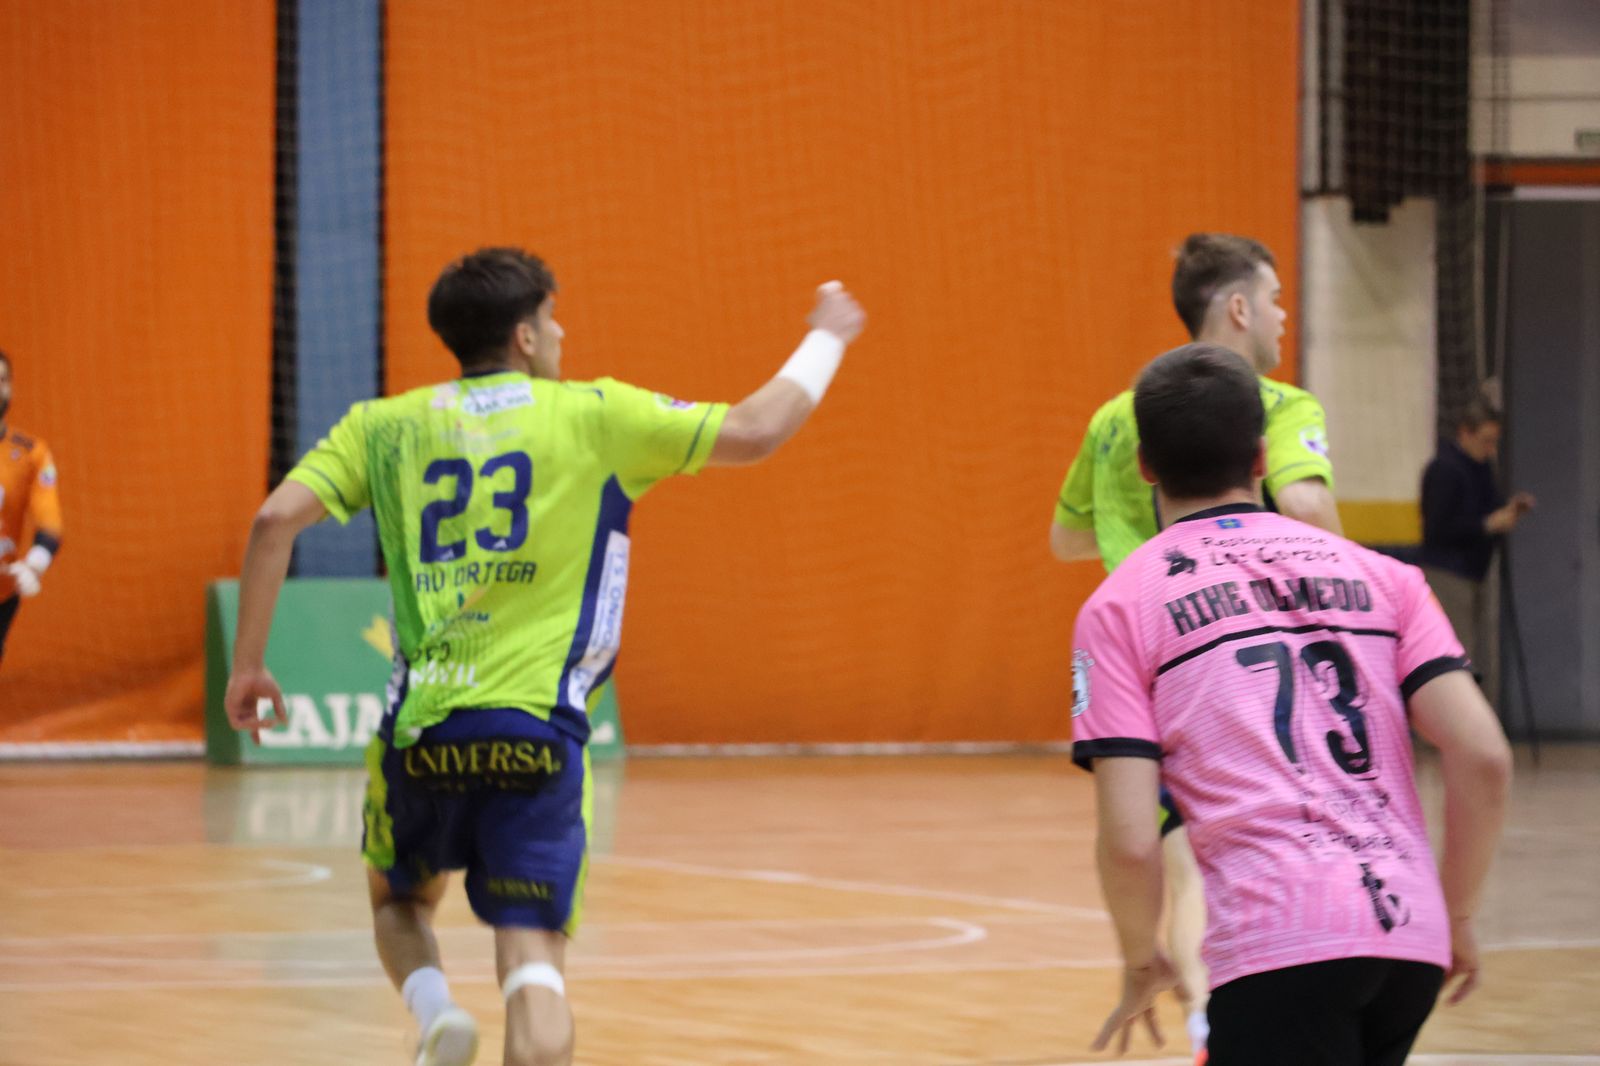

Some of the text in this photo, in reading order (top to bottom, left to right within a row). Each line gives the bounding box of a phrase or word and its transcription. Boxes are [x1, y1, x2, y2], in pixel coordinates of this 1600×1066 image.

[420, 450, 533, 563] 23
[454, 560, 538, 587] ORTEGA
[1235, 639, 1373, 778] 73
